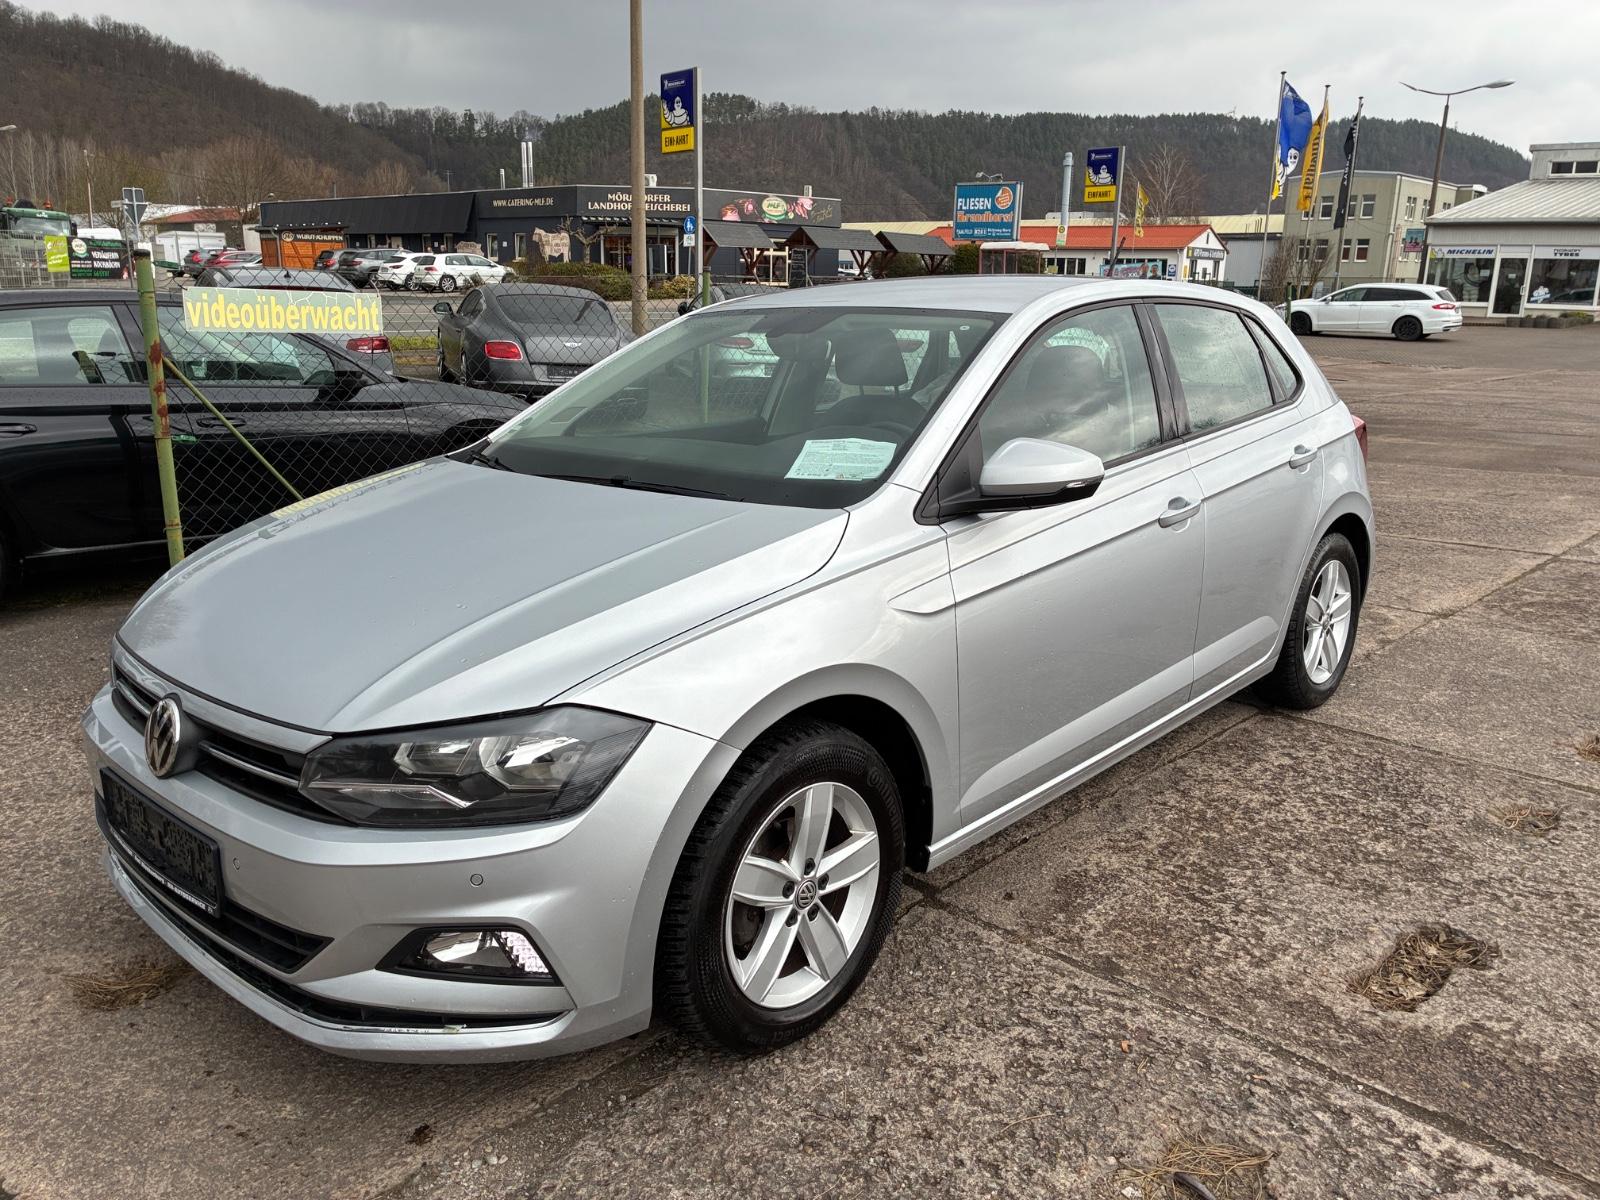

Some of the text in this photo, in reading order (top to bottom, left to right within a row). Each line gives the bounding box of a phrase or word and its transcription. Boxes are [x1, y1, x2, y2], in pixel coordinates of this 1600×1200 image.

[664, 134, 689, 147] EINFAHRT
[607, 191, 671, 203] MÖRSRFER
[1087, 191, 1112, 199] EINFAHRT
[588, 201, 691, 212] LANDHOFEISCHEREI
[957, 197, 992, 210] FLIESEN
[186, 293, 380, 331] videoüberwacht
